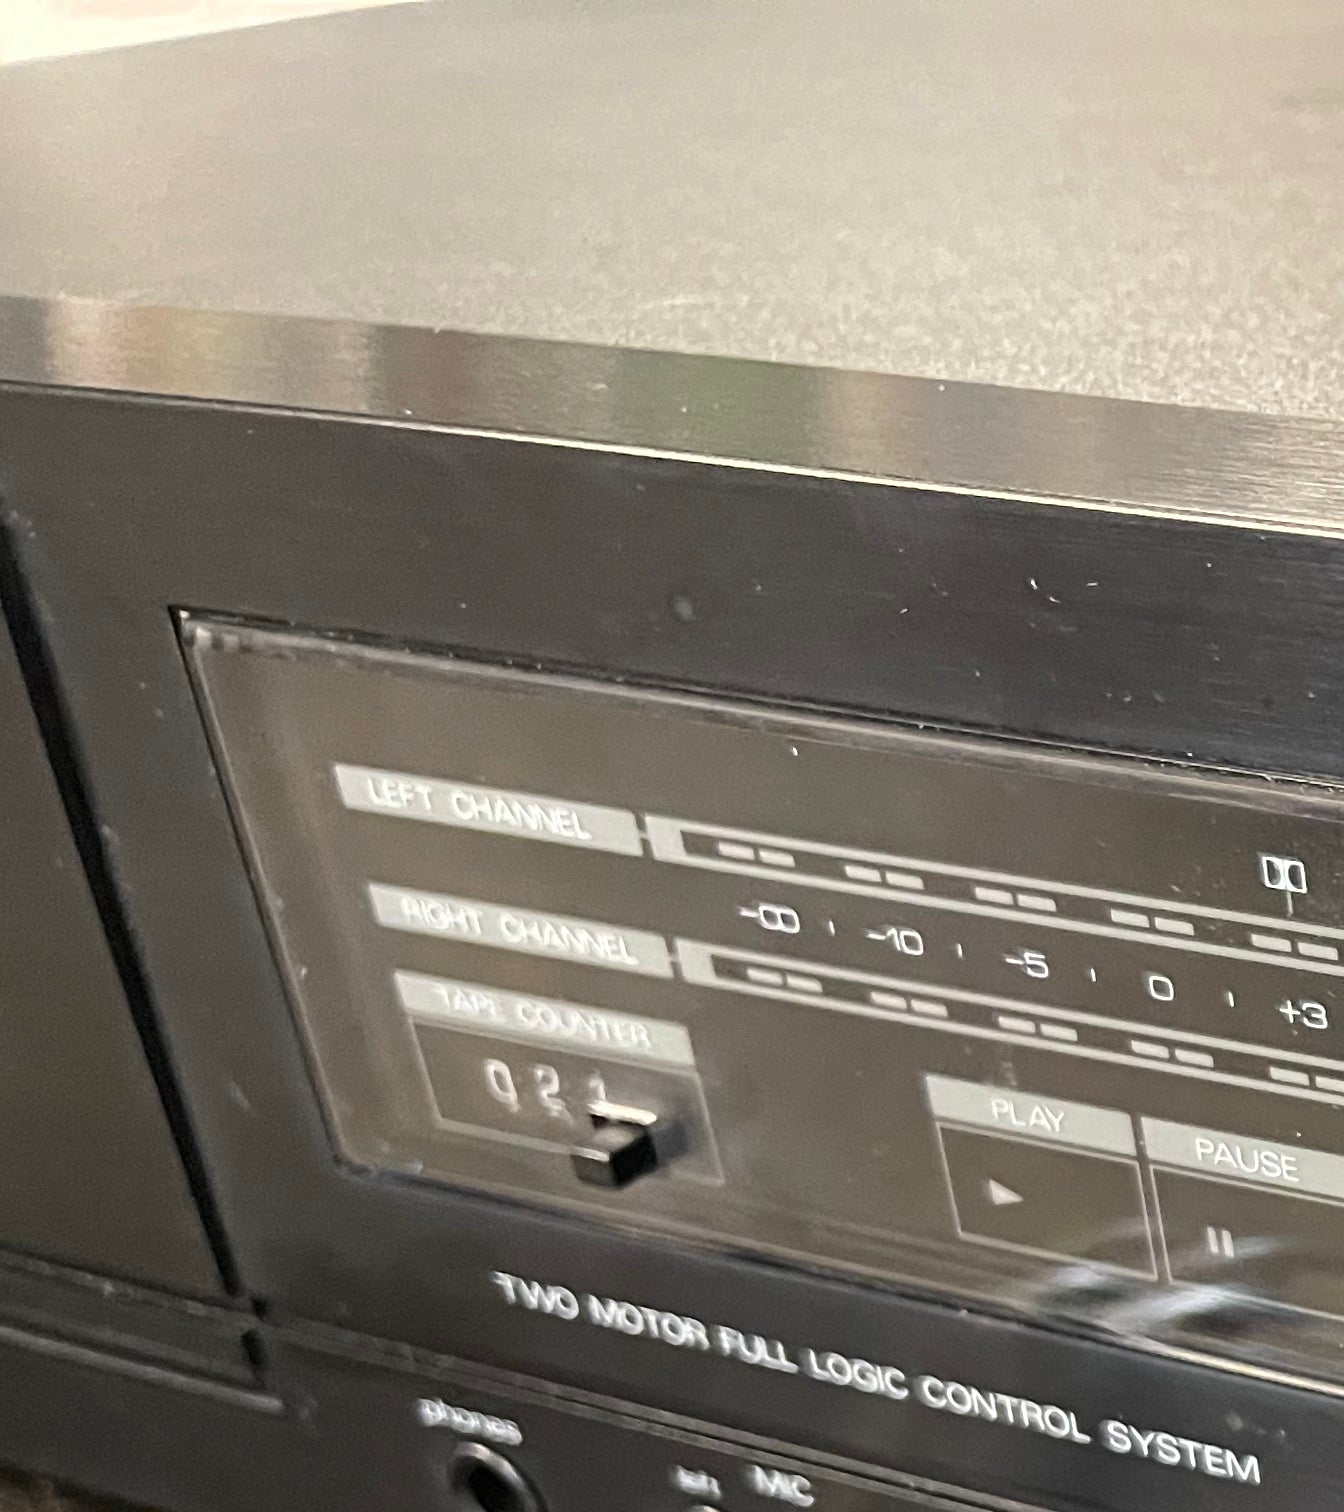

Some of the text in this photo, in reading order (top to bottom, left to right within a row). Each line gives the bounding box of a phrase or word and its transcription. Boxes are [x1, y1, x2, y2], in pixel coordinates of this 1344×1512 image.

[366, 776, 592, 840] LEFT CHANNEL
[400, 896, 638, 965] RIGHT CHANNEL
[866, 926, 924, 957] -10
[1004, 951, 1050, 979] -5
[1278, 1000, 1329, 1031] +3
[514, 1000, 652, 1048] COUNTER
[990, 1099, 1066, 1135] PLAY
[1194, 1138, 1301, 1184] PAUSE
[493, 1269, 1262, 1486] TWO MOTOR FULL LOGIC CONTROL SYSTEM
[417, 1398, 522, 1446] phones
[748, 1464, 815, 1508] MIC
